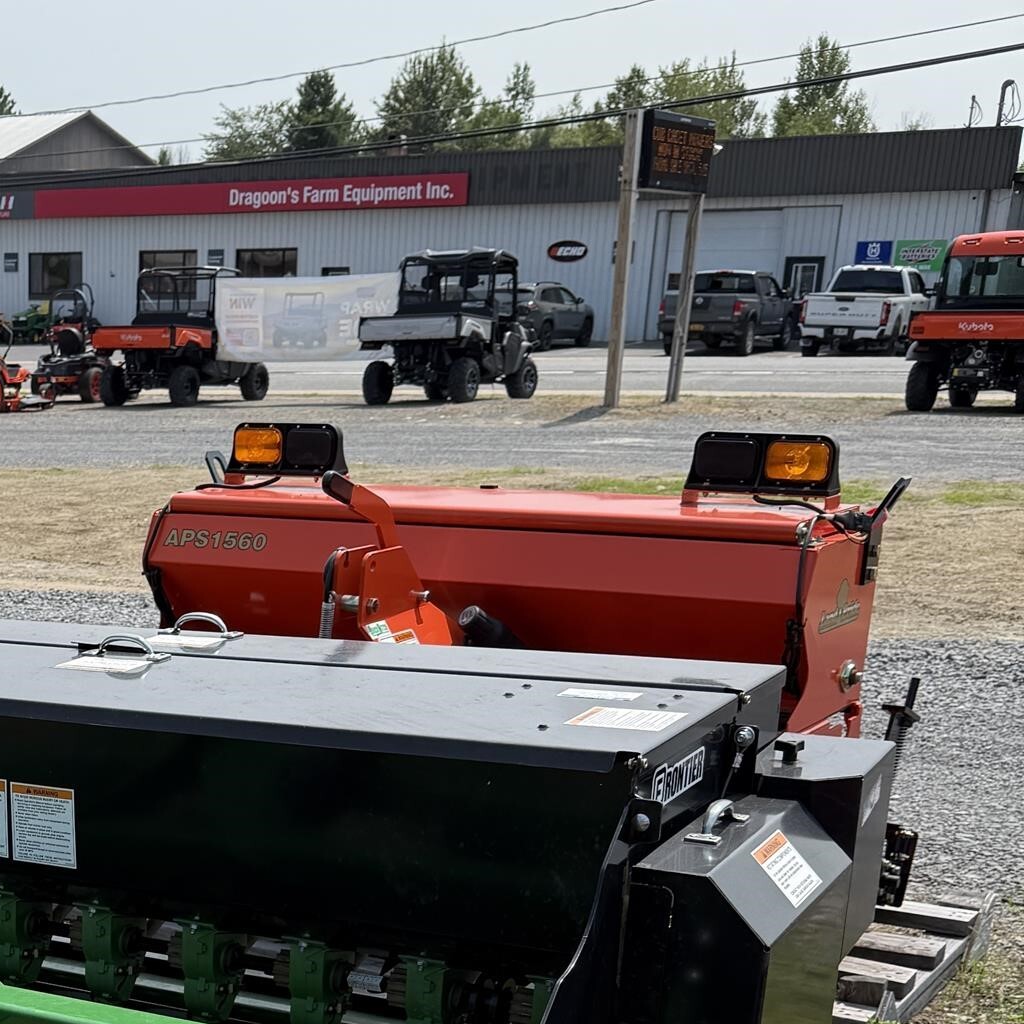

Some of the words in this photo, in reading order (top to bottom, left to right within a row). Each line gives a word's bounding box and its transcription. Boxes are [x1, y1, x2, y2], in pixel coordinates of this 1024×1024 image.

[229, 187, 299, 208] Dragoon's
[303, 186, 339, 203] Farm
[343, 184, 423, 205] Equipment
[426, 181, 454, 199] Inc.
[557, 246, 586, 257] ECHO
[958, 321, 994, 331] Kubota
[164, 528, 267, 551] APS1560
[652, 747, 704, 803] FRONTIER
[33, 788, 58, 797] WARNING
